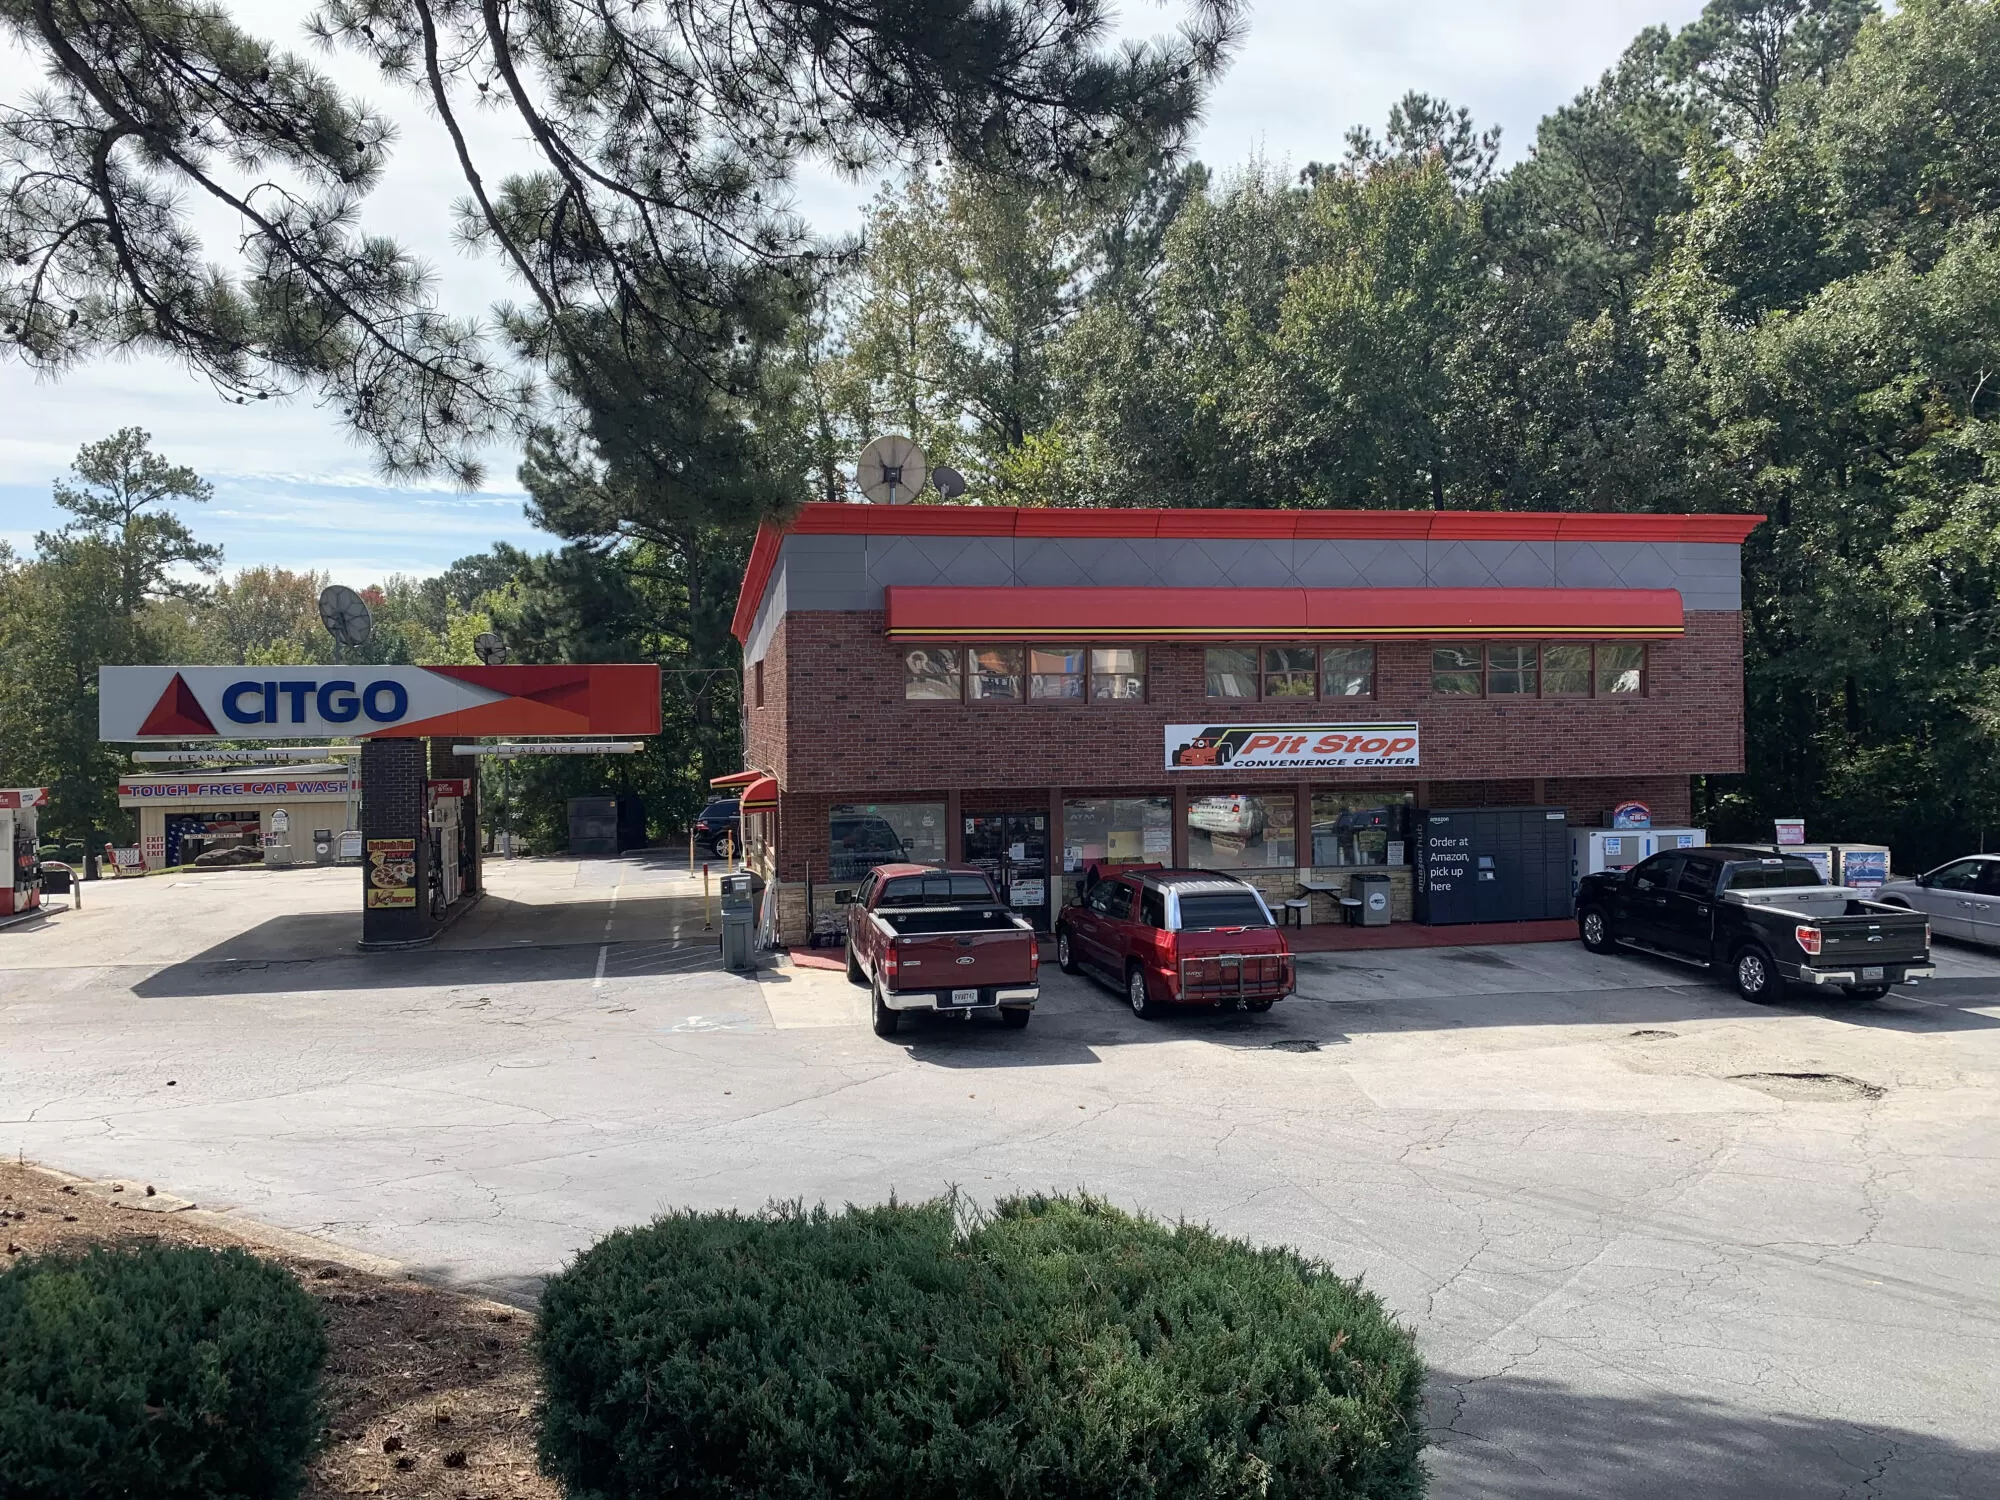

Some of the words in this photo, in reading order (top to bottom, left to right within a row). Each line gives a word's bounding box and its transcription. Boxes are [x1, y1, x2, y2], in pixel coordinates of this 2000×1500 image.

[222, 680, 409, 724] CITGO
[1240, 735, 1308, 755] Pit
[1312, 734, 1417, 757] Stop
[1233, 758, 1346, 768] CONVENIENCE
[1353, 757, 1415, 766] CENTER
[129, 785, 188, 797] TOUCH
[197, 784, 244, 796] FREE
[252, 783, 288, 794] CAR
[297, 781, 348, 794] WASH
[1430, 837, 1456, 847] Order
[1459, 837, 1468, 847] at
[1430, 852, 1470, 863] Amazon,
[1430, 866, 1449, 879] pick
[1451, 868, 1464, 878] up
[1430, 882, 1452, 892] here
